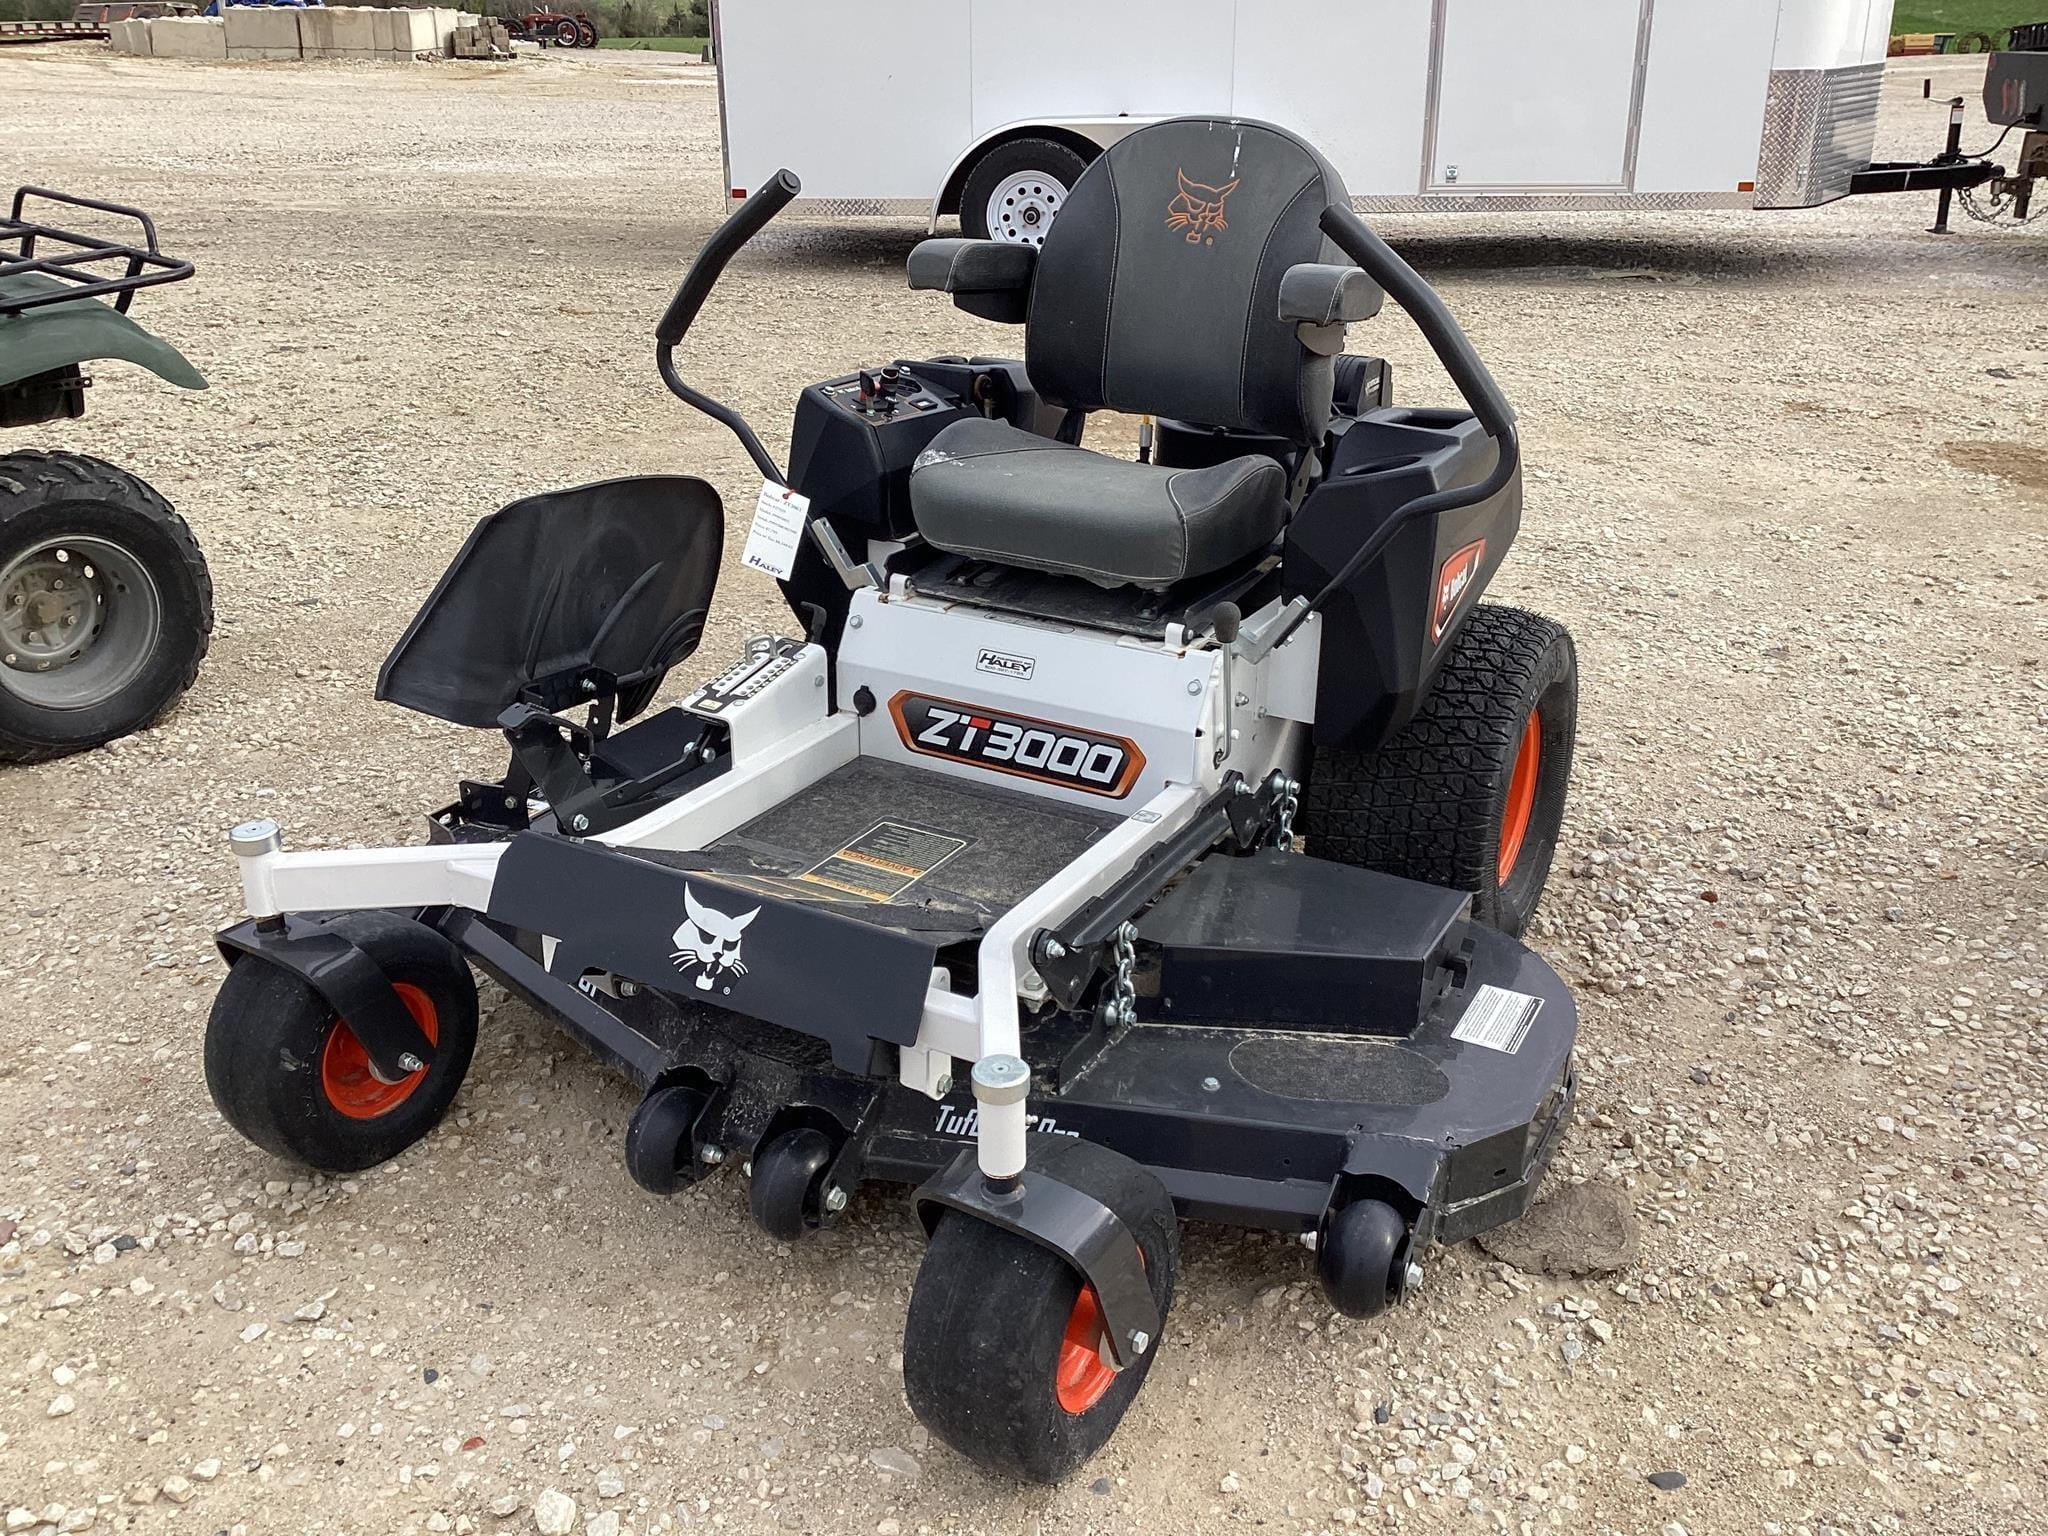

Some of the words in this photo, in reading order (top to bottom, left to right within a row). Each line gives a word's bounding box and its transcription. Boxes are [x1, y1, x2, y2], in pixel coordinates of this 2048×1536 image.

[749, 555, 784, 574] HALEY
[979, 653, 1032, 672] HALEY
[917, 707, 1125, 784] ZT3000
